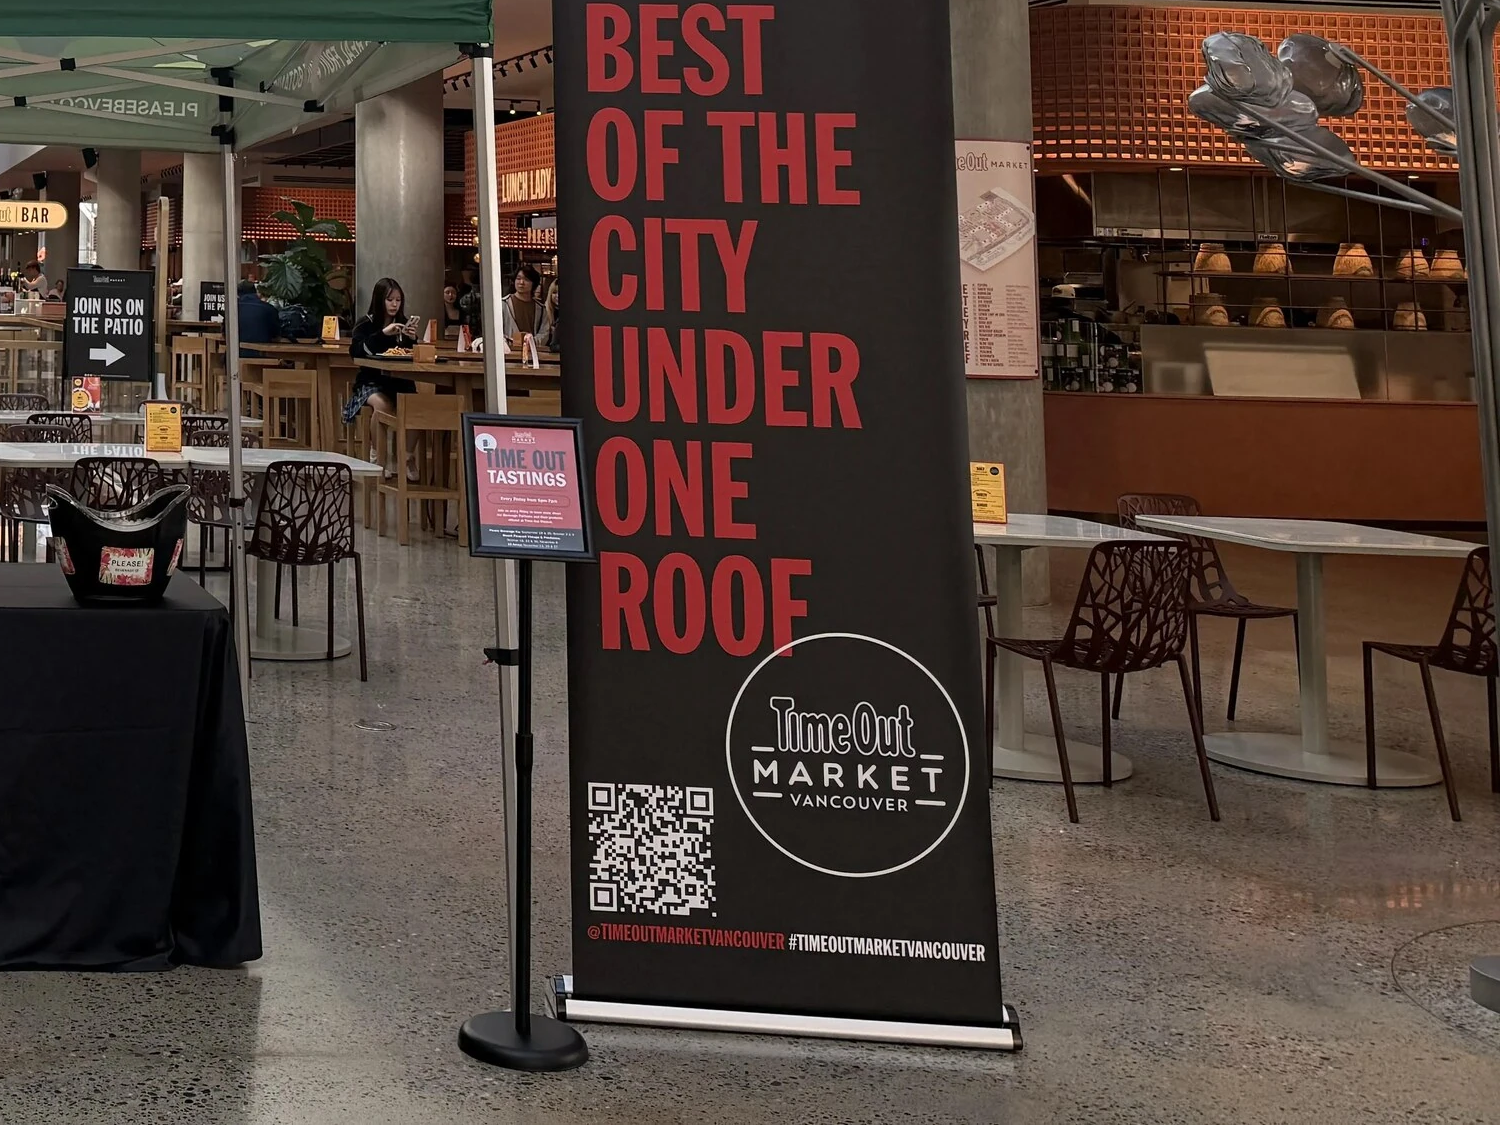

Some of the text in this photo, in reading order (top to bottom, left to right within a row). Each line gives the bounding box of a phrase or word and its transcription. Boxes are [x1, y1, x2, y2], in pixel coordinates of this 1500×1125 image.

[586, 3, 775, 96] BEST
[586, 107, 860, 205] OF THE
[990, 161, 1028, 169] MARKET
[502, 167, 552, 204] LUNCH LADY
[21, 207, 49, 223] BAR
[589, 214, 758, 313] CITY
[73, 297, 144, 316] JOIN US ON
[73, 317, 143, 336] THE PATIO
[593, 325, 863, 429] UNDER
[483, 448, 567, 471] TIME OUT
[487, 469, 567, 487] TASTINGS
[596, 436, 757, 540] ONE
[599, 551, 812, 657] ROOF
[770, 696, 916, 757] Time Out
[753, 759, 943, 793] MARKET
[790, 793, 908, 812] VANCOUVER
[587, 922, 986, 962] @TIMEOUTMARKETVANCOUVER #TIMEOUTMARKETVANCOUVER
